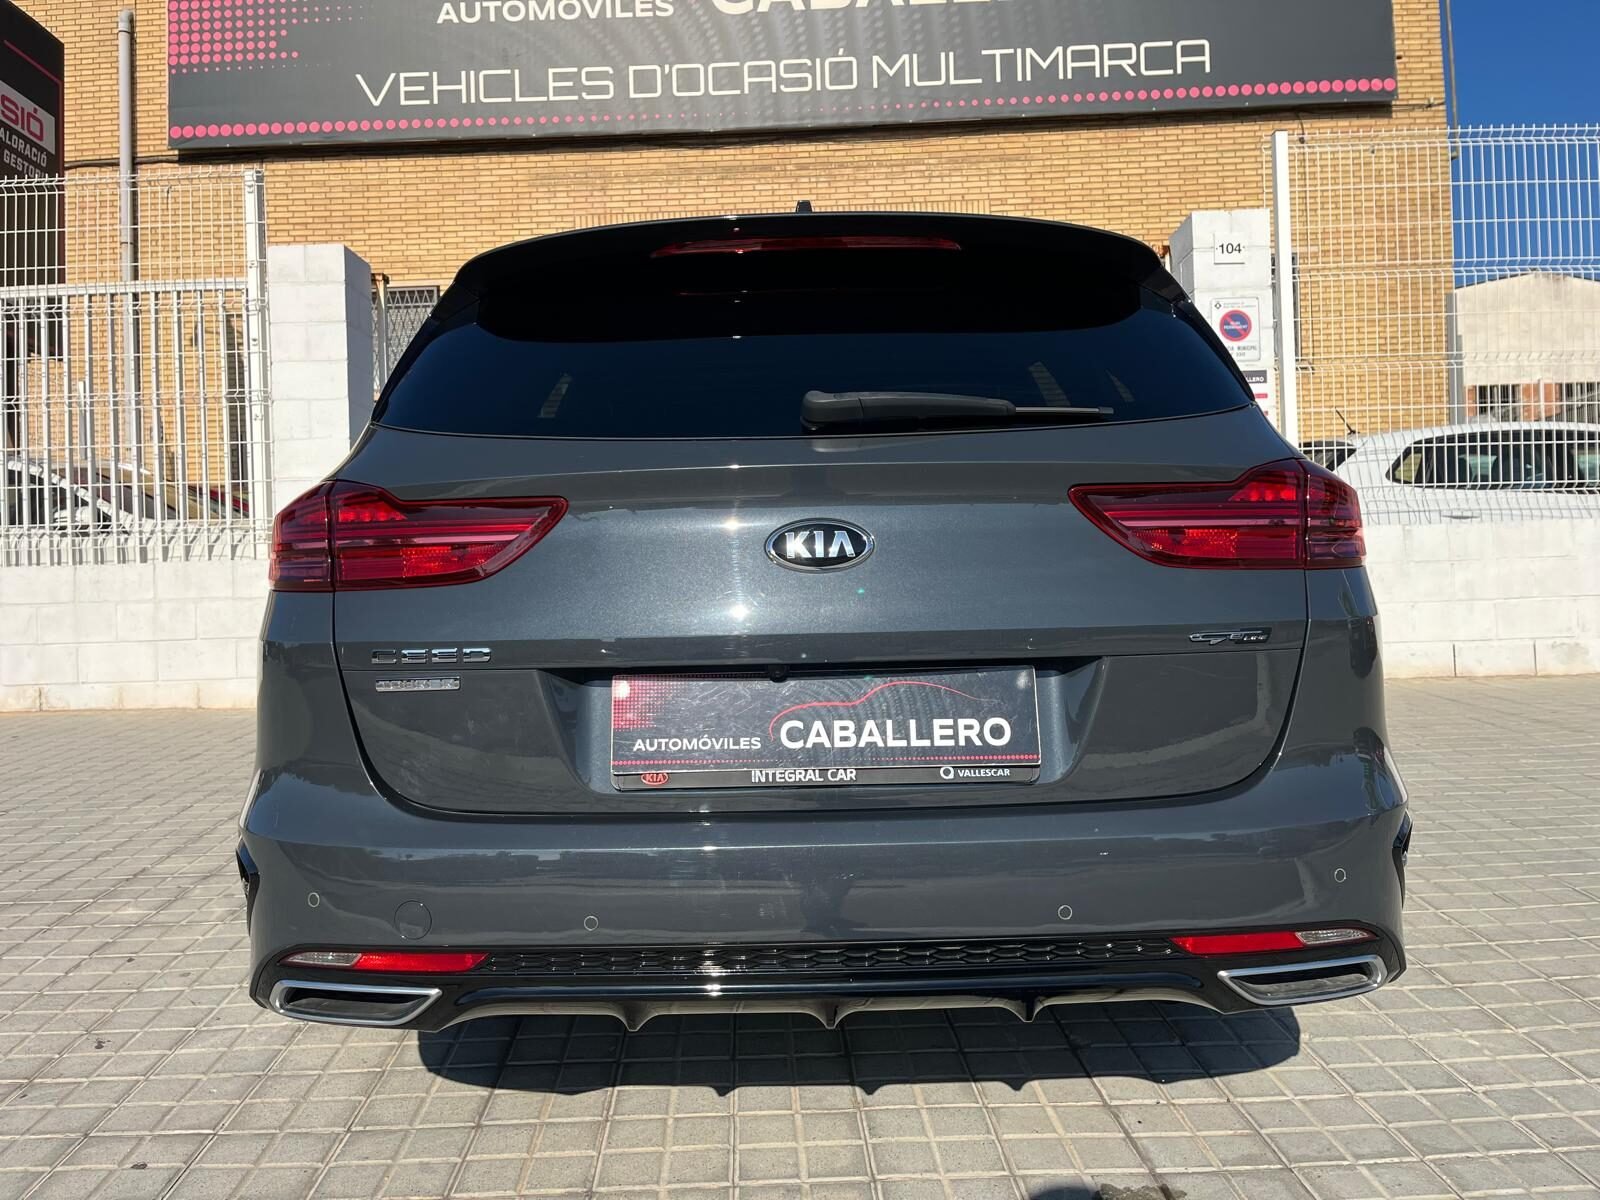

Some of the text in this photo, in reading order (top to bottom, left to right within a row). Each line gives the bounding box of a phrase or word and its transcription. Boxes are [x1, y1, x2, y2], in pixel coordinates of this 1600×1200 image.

[355, 38, 1211, 106] VEHICLES D'OCASIÓ MULTIMARCA
[1218, 242, 1242, 254] 104
[784, 530, 856, 559] KIA
[371, 647, 492, 664] CEED
[633, 717, 1012, 752] AUTOMÓVILES CABALLERO
[645, 773, 664, 782] KIA
[751, 768, 857, 783] INTEGRAL CAR
[957, 768, 1011, 777] VALLESCAR
